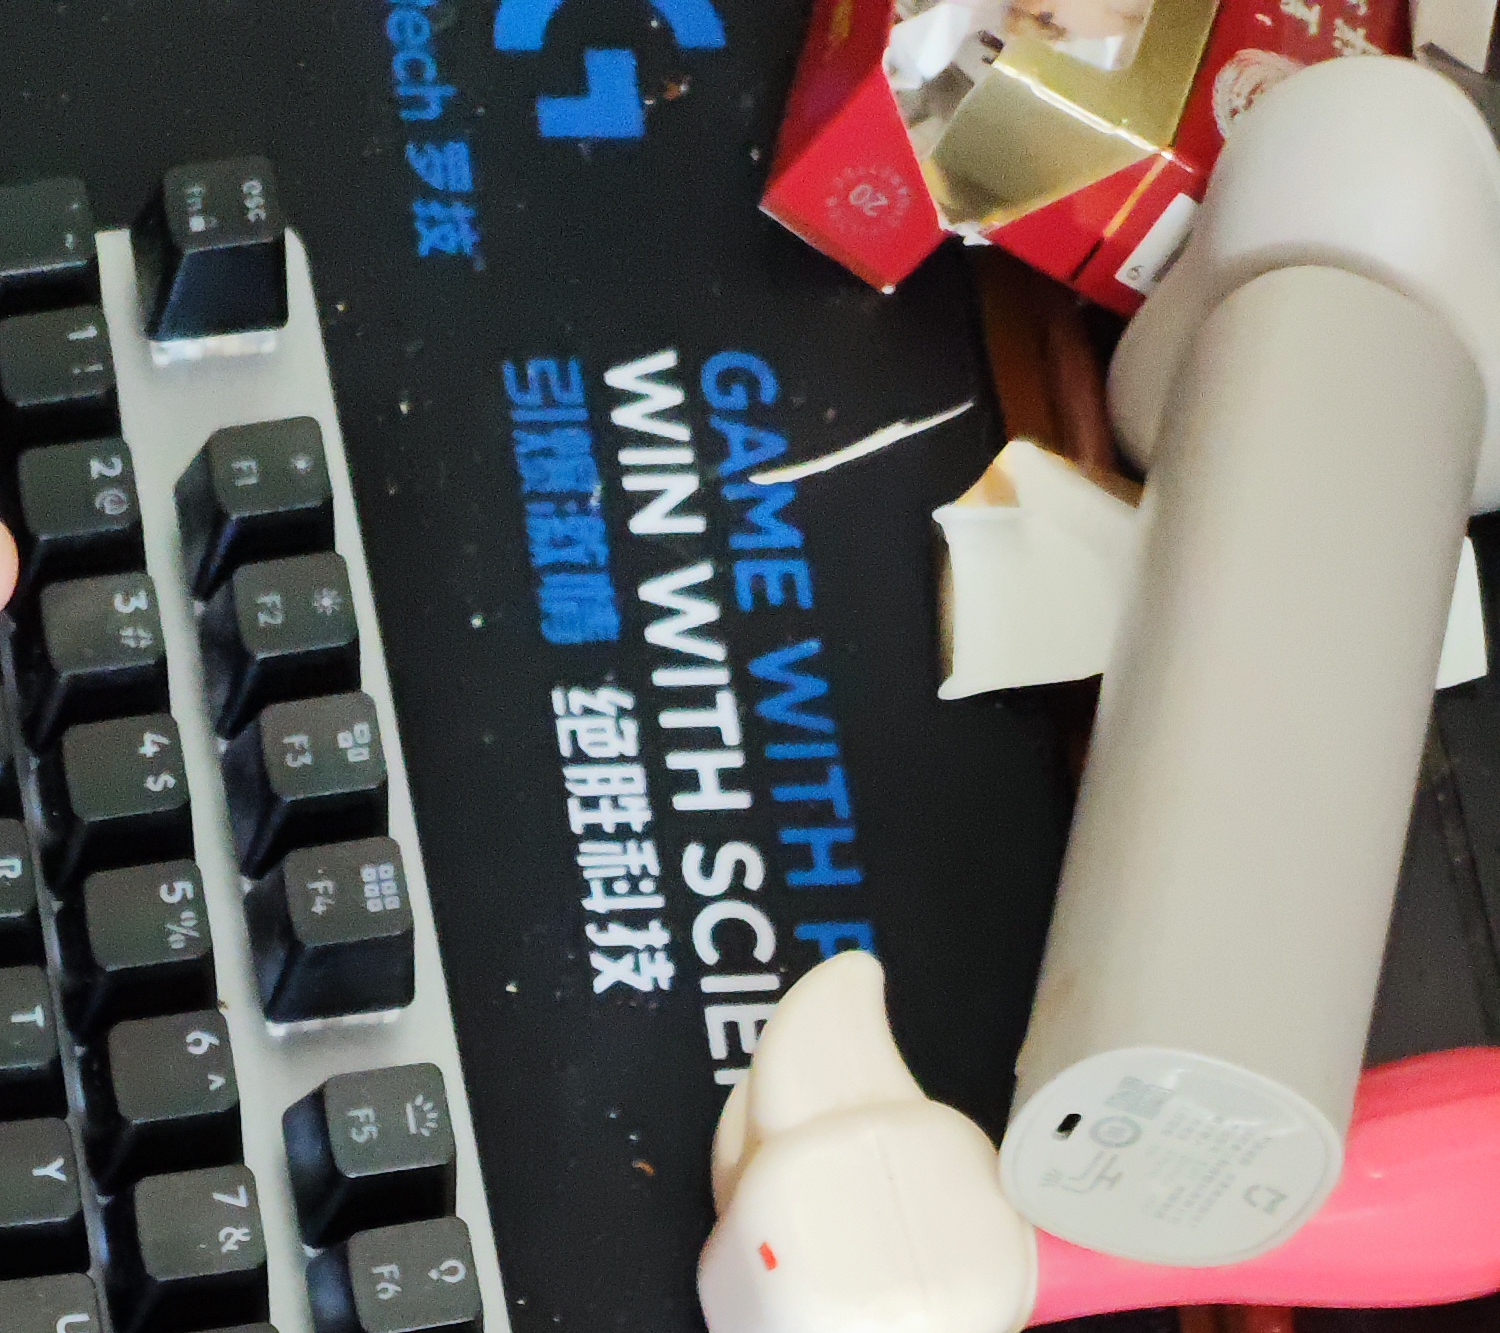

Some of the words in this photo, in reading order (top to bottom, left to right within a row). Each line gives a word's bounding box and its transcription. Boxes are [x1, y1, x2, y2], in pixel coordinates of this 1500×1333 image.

[385, 0, 457, 121] ech
[241, 178, 267, 222] esc
[67, 324, 98, 340] 1
[603, 350, 706, 537] WIN
[89, 456, 123, 479] 2
[231, 458, 259, 487] F1
[701, 352, 814, 612] GAME
[113, 589, 148, 615] 3
[256, 592, 284, 627] F2
[636, 562, 751, 811] WITH
[138, 731, 170, 758] 4
[282, 733, 313, 768] F3
[747, 639, 864, 888] WITH
[551, 686, 674, 994] 绝胜科技
[159, 880, 194, 904] 5
[307, 879, 335, 915] F4
[681, 839, 781, 1087] SCIE
[10, 1005, 45, 1028] T
[185, 1030, 220, 1056] 6
[347, 1106, 378, 1143] F5
[32, 1157, 67, 1182] Y
[212, 1185, 248, 1208] 7
[371, 1263, 402, 1300] F6
